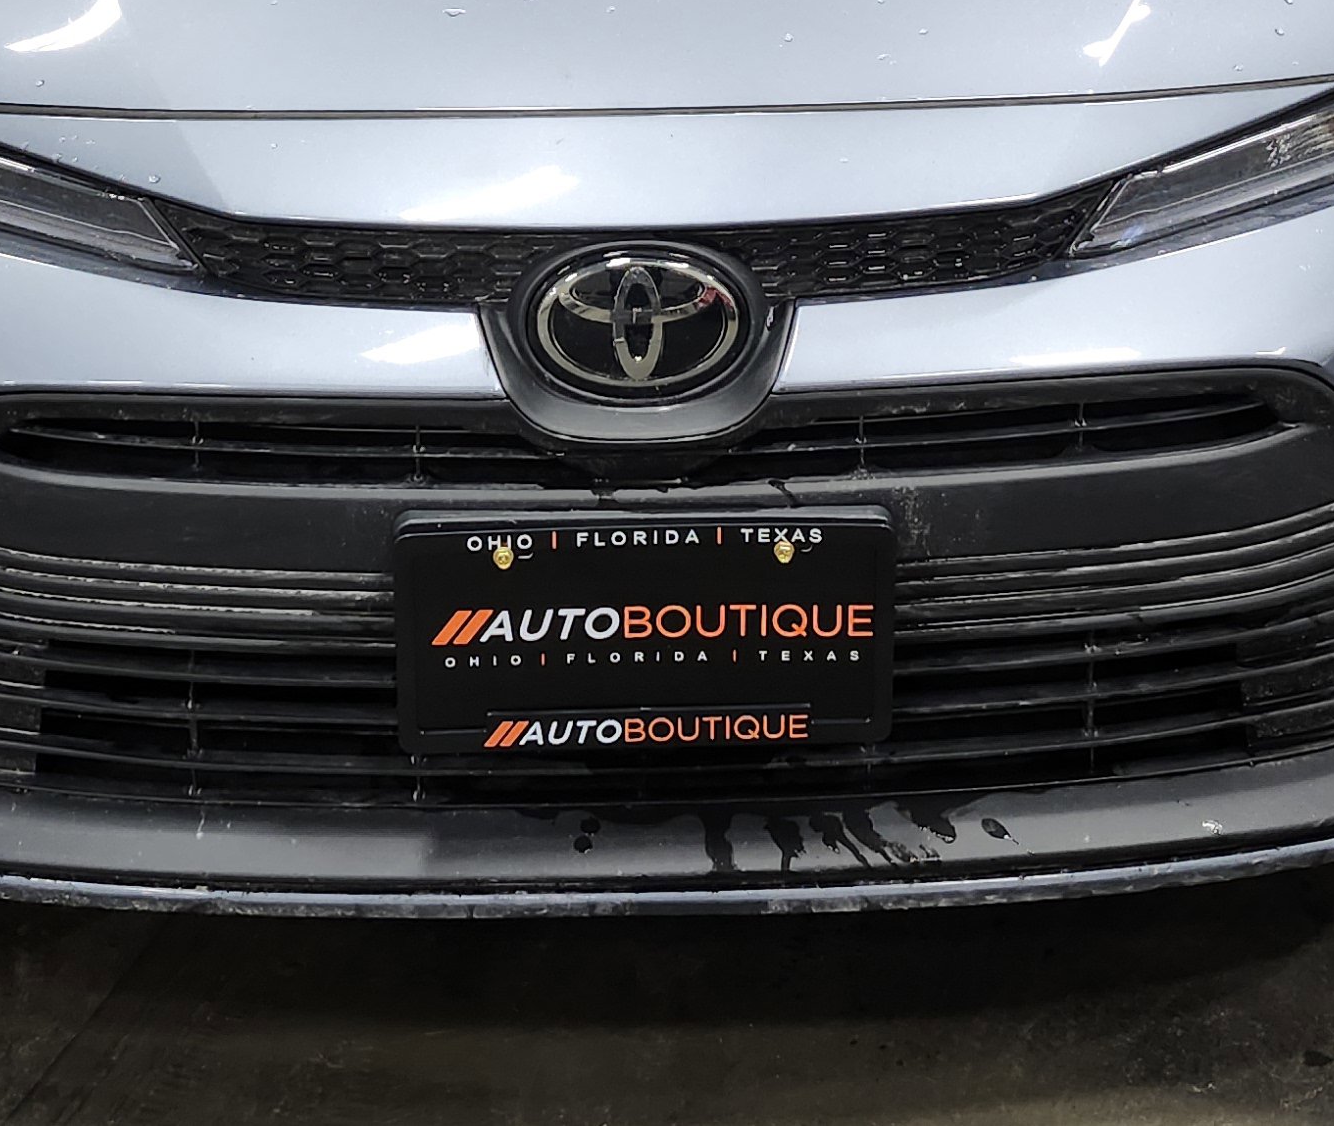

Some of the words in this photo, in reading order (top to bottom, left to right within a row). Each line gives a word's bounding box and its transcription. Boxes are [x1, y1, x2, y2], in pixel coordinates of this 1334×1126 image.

[467, 534, 533, 552] OHIO
[576, 528, 701, 547] FLORIDA
[740, 527, 823, 544] TEXAS
[479, 603, 874, 643] AUTOBOUTIQUE
[444, 653, 523, 668] OHIO
[566, 650, 708, 664] FLORIDA
[758, 649, 861, 662] TEXAS
[519, 714, 809, 746] AUTOBOUTIQUE
